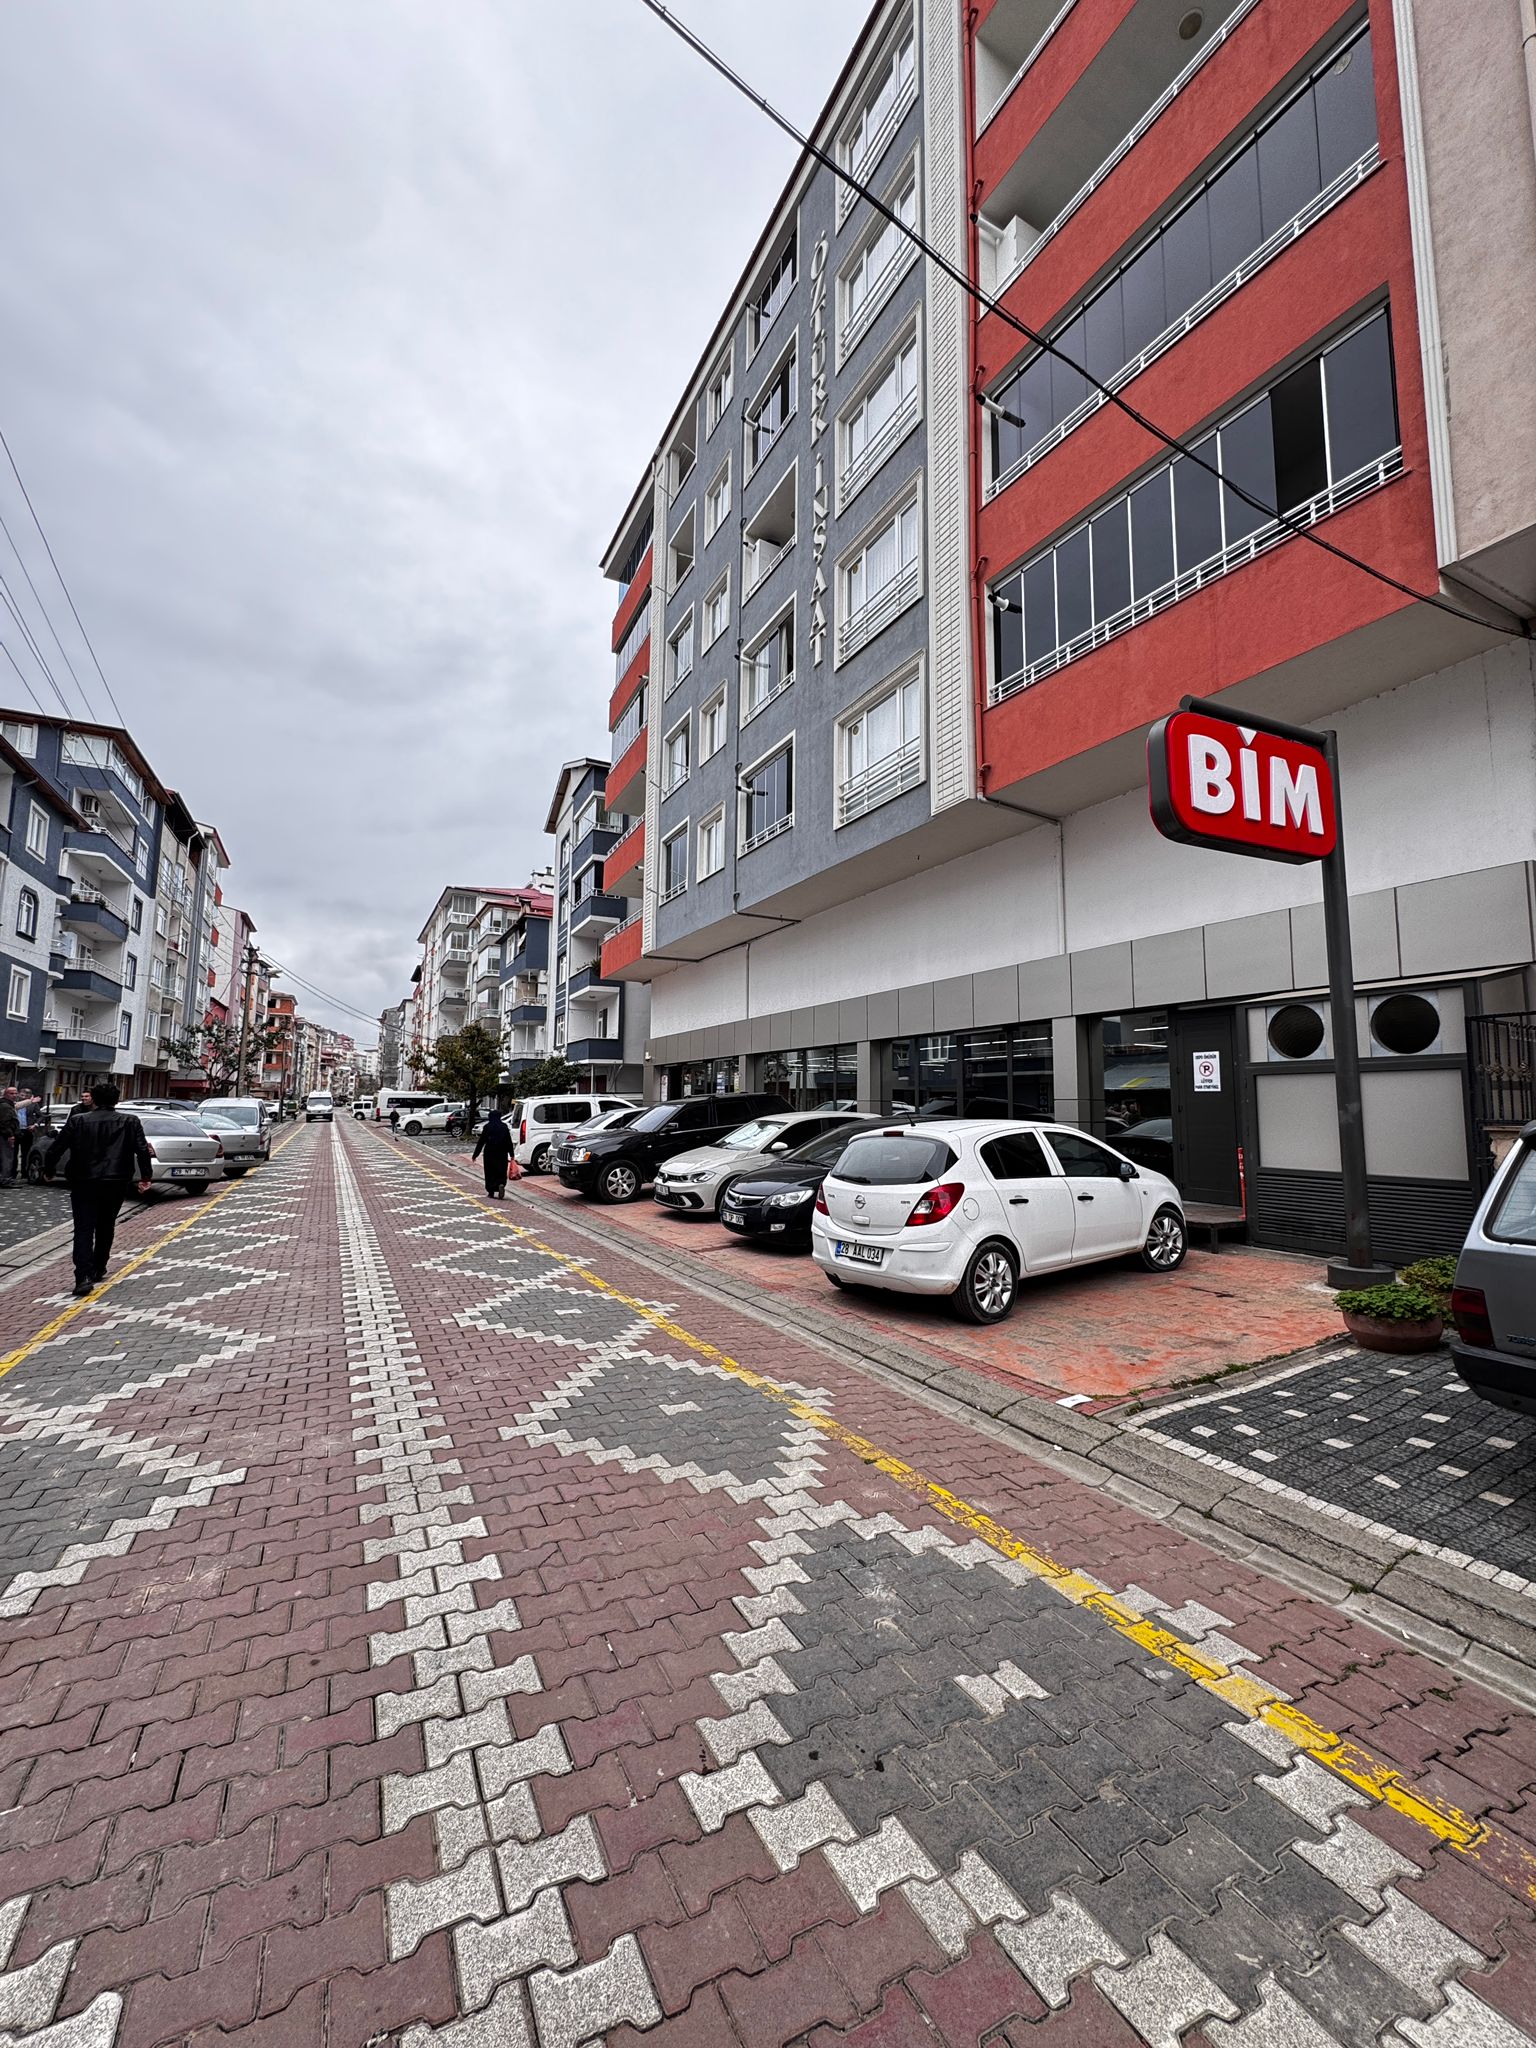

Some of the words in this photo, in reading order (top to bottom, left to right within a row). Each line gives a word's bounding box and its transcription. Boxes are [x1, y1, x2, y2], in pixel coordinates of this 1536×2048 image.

[1187, 726, 1325, 836] BİM
[840, 1242, 850, 1255] 28
[852, 1244, 866, 1258] AAL
[867, 1247, 880, 1261] 034
